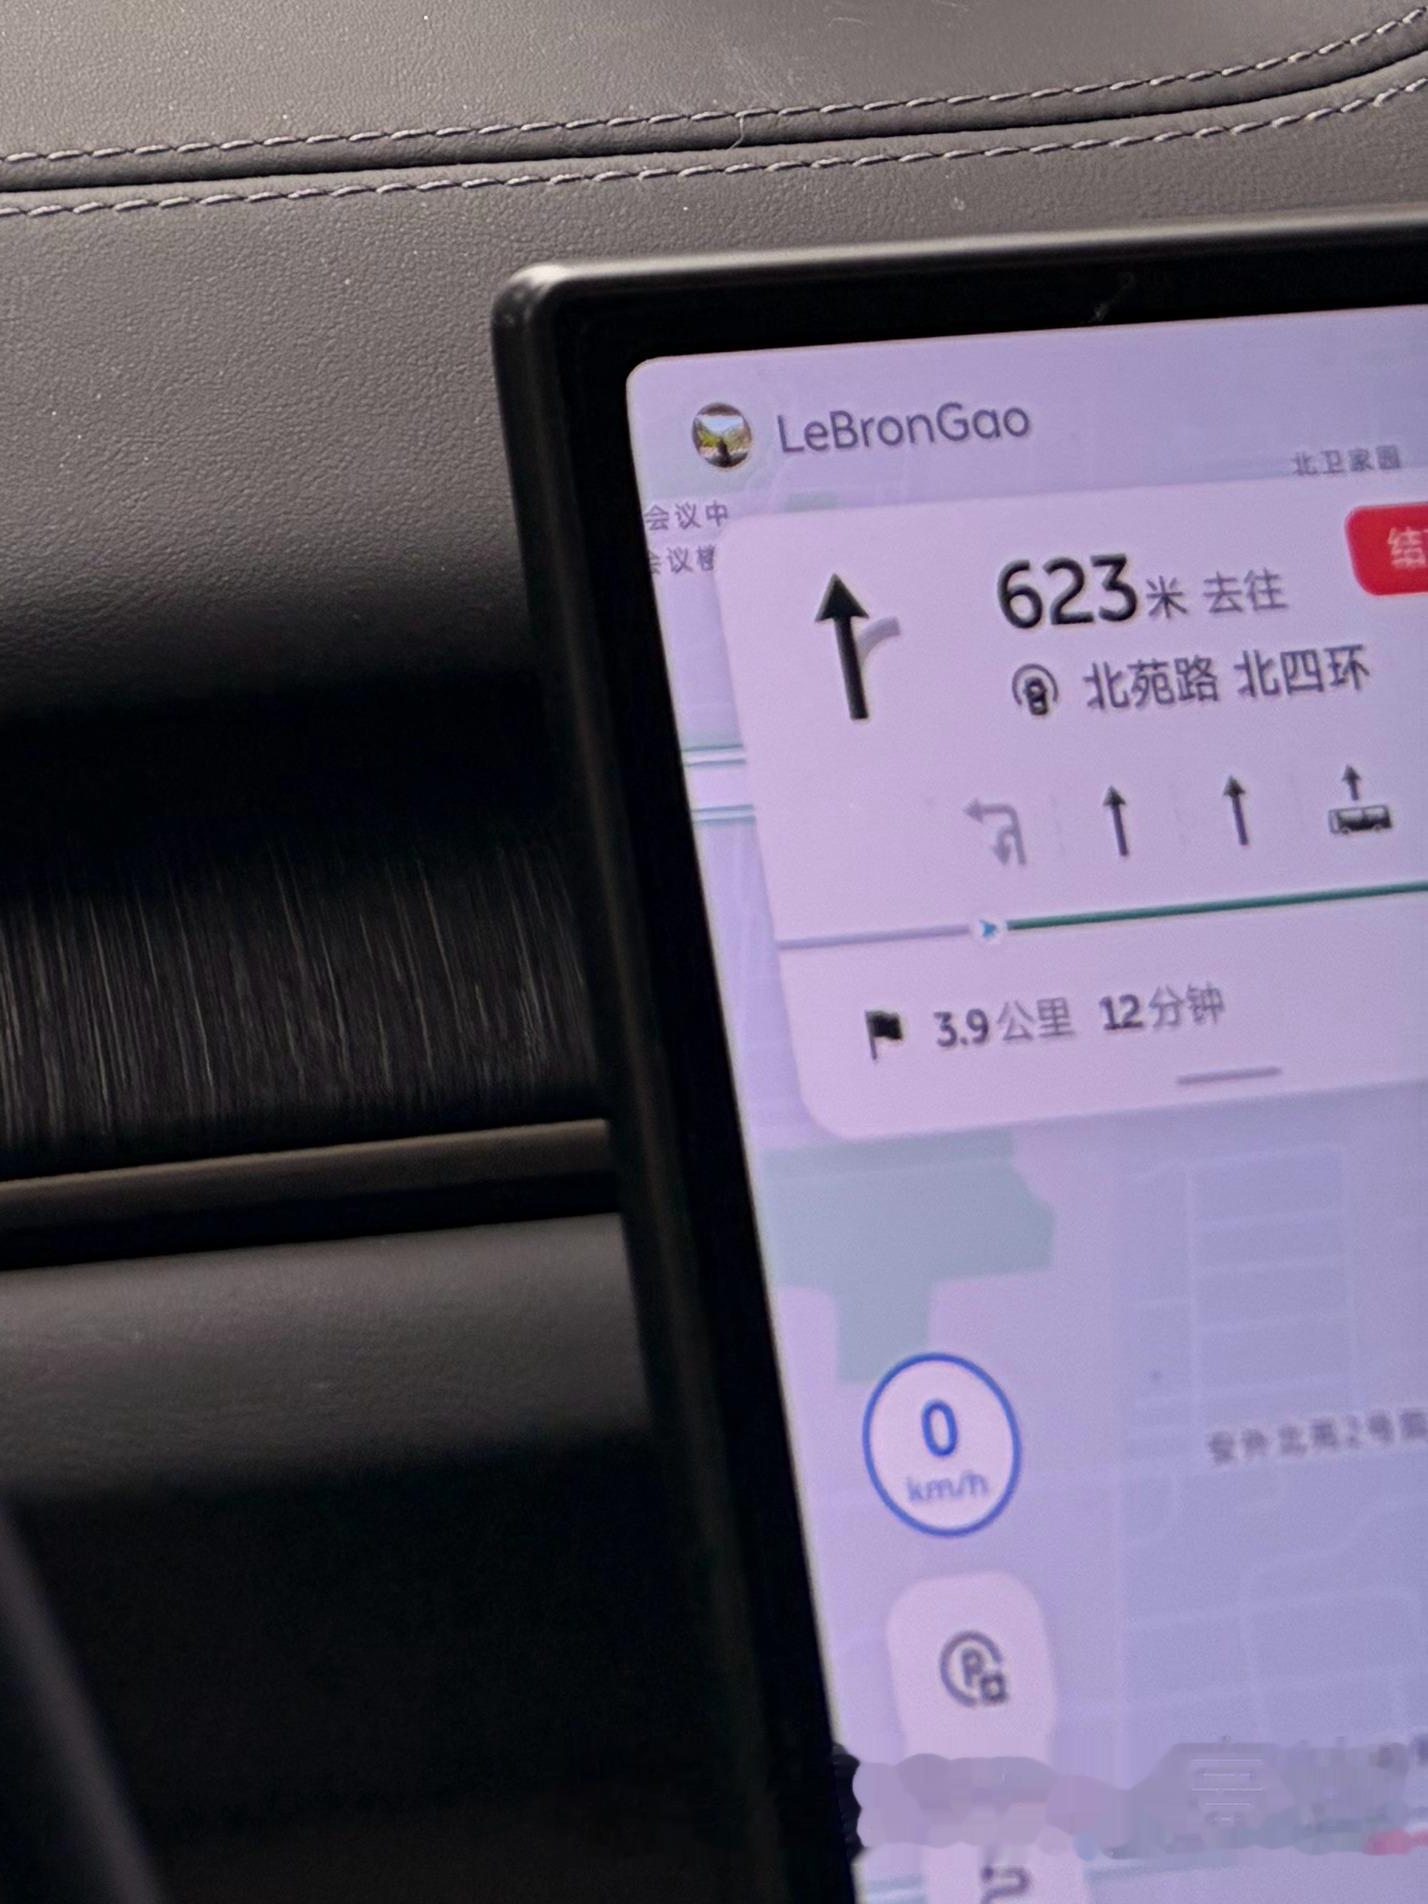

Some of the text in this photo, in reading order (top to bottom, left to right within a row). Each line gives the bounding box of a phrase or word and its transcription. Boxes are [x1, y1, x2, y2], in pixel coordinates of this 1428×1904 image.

[777, 401, 1031, 454] LeBronGao
[1387, 525, 1428, 570] 结
[1203, 567, 1289, 615] 去往
[1083, 643, 1371, 711] 北苑路 北四环
[921, 1399, 959, 1458] 0
[906, 1470, 990, 1503] km/h
